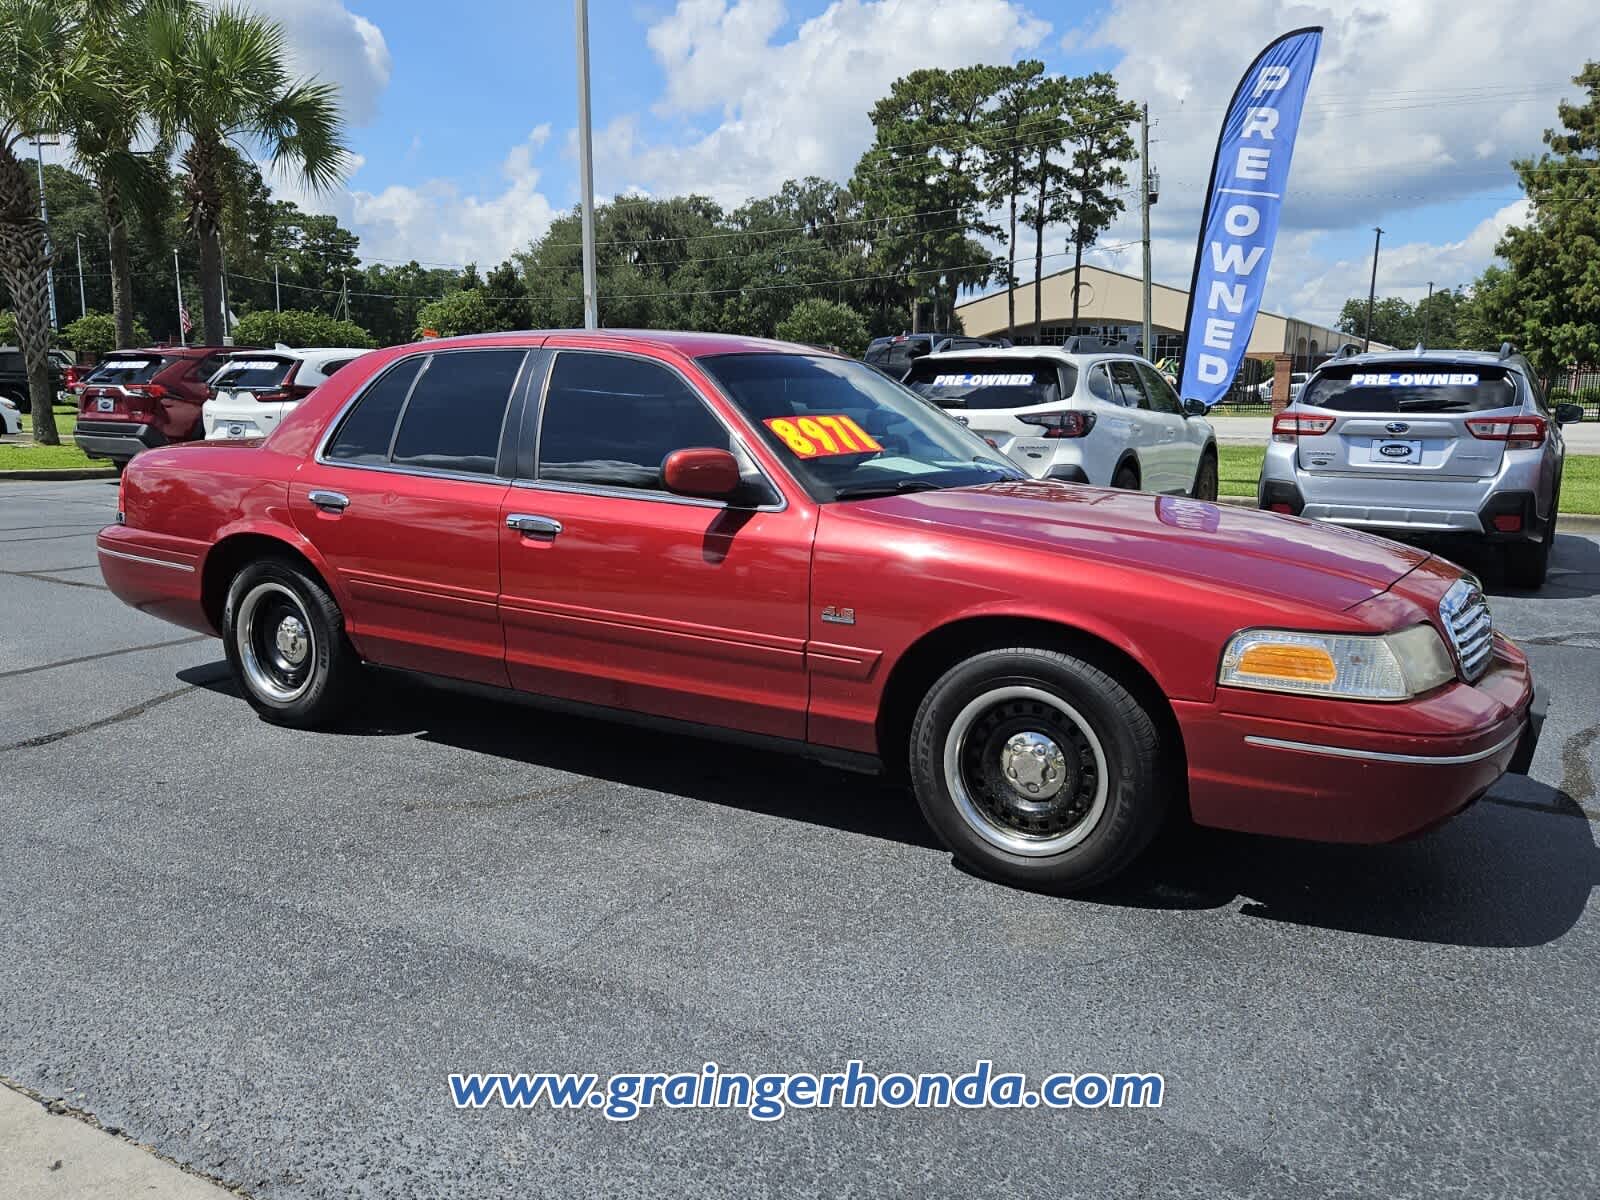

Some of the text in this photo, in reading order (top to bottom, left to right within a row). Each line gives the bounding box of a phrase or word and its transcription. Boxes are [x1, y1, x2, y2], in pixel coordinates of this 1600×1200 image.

[932, 374, 1034, 386] PRE-OWNED
[1350, 373, 1479, 386] PRE-OWNED
[770, 415, 881, 456] 8971
